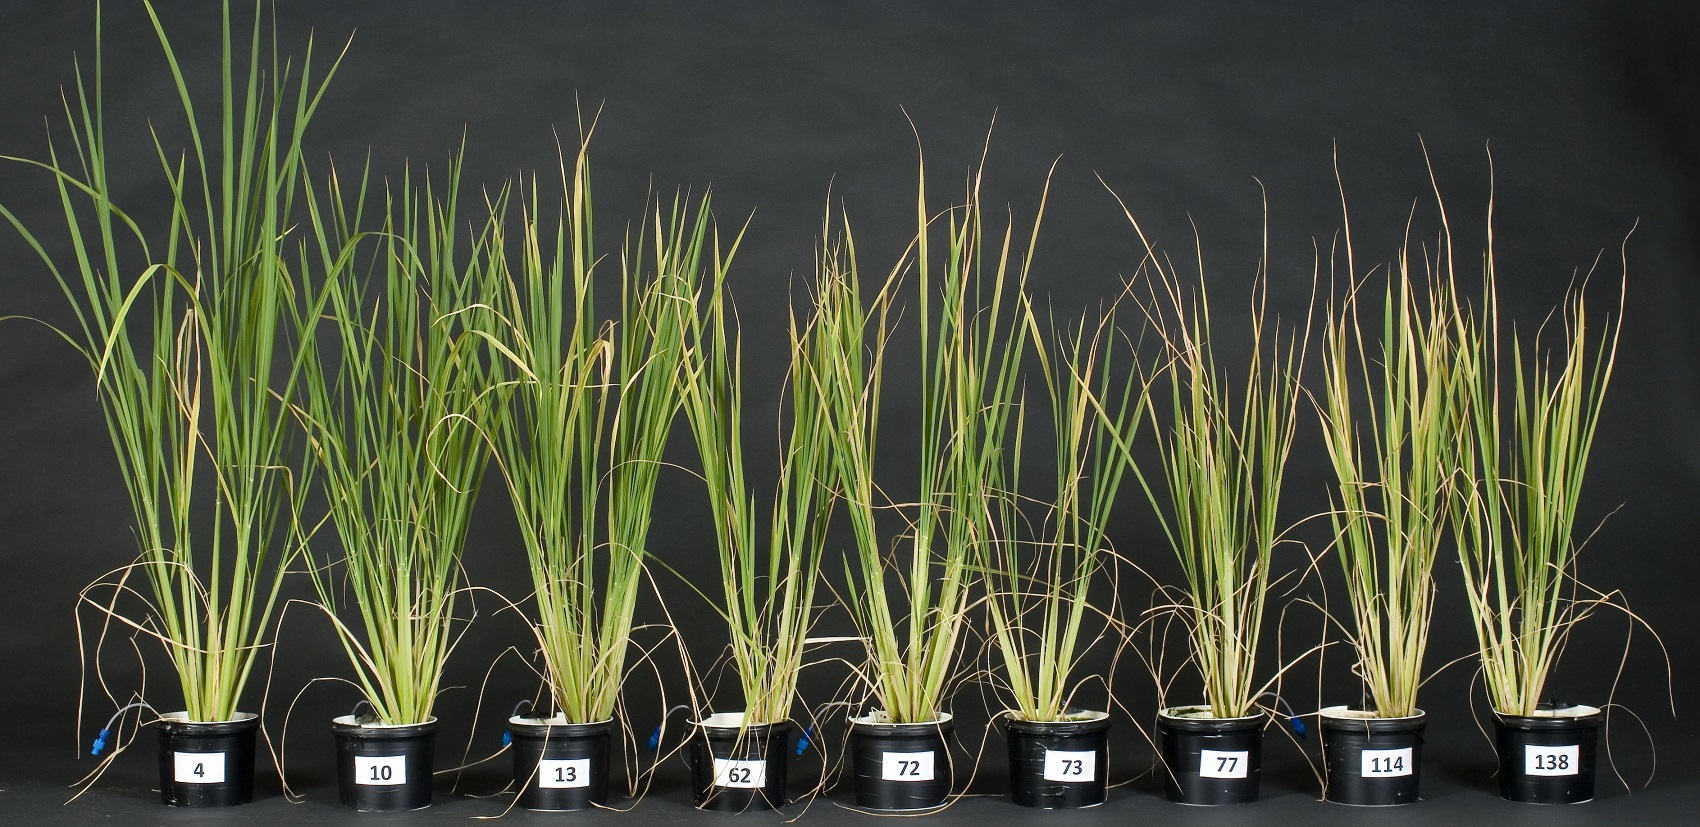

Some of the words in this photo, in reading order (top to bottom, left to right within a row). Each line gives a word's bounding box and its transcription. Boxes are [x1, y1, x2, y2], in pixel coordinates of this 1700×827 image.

[193, 762, 205, 778] 4
[898, 760, 920, 776] 72
[1061, 759, 1083, 776] 73
[1216, 756, 1238, 773] 77
[1371, 756, 1404, 773] 114
[1535, 754, 1569, 770] 138
[370, 765, 392, 781] 10
[555, 766, 577, 782] 13
[728, 767, 751, 783] 62
